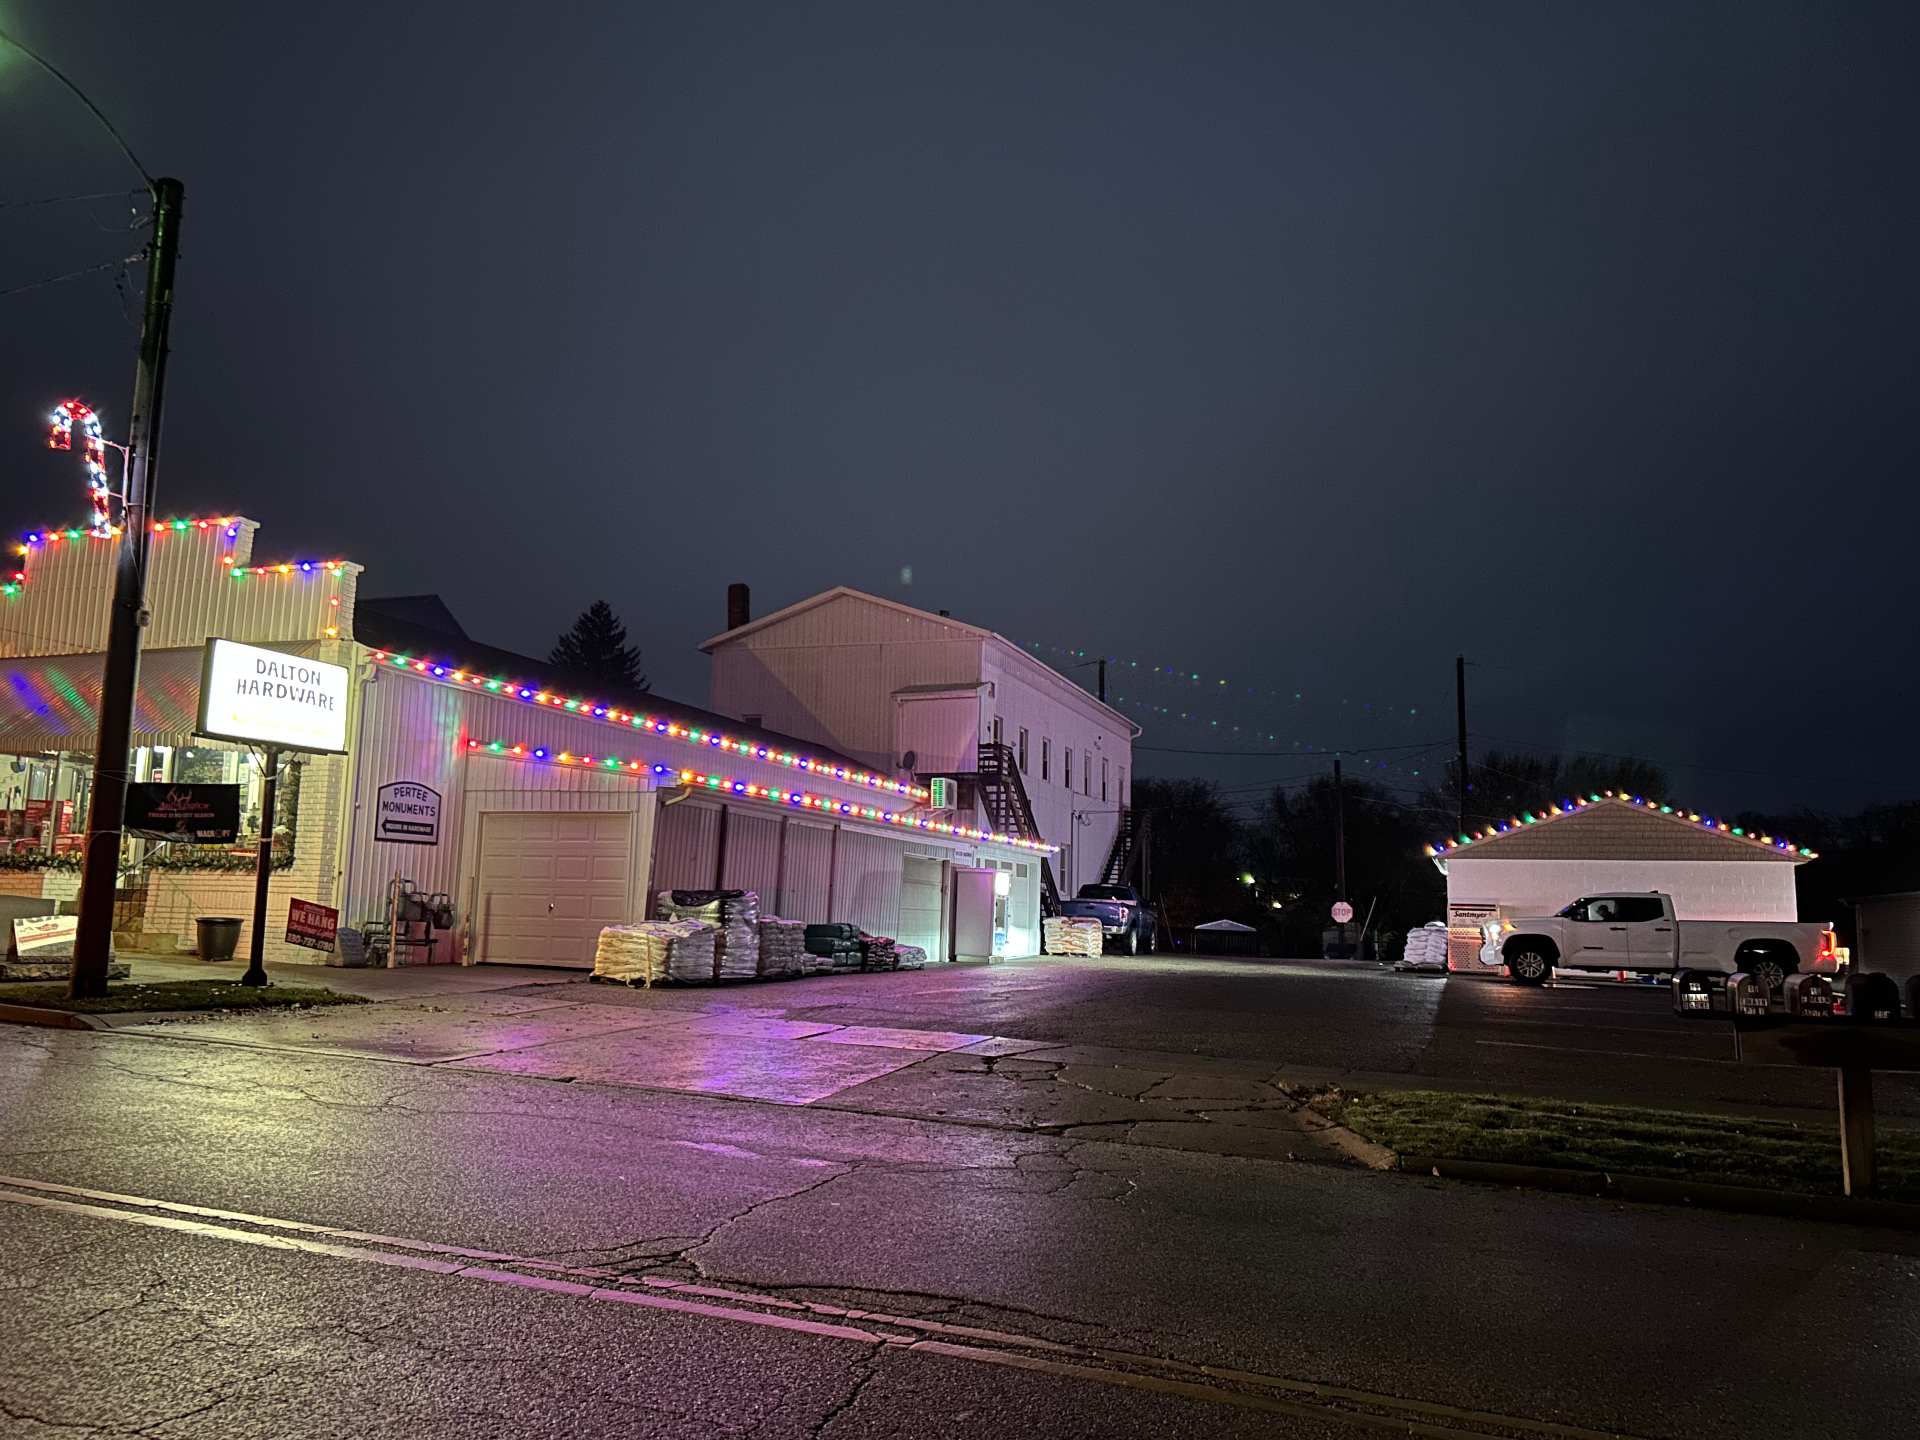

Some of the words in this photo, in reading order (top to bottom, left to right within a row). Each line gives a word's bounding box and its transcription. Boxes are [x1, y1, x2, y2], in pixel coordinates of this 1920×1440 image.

[256, 658, 321, 686] DALTON
[236, 678, 335, 712] HARDWARE
[394, 786, 429, 802] PERTEE
[382, 800, 436, 817] MONUMENTS
[291, 908, 307, 923] WE
[307, 912, 335, 931] HANG
[1332, 908, 1352, 917] STOP
[1453, 910, 1488, 920] Santmyer
[1688, 994, 1709, 1002] MAIN
